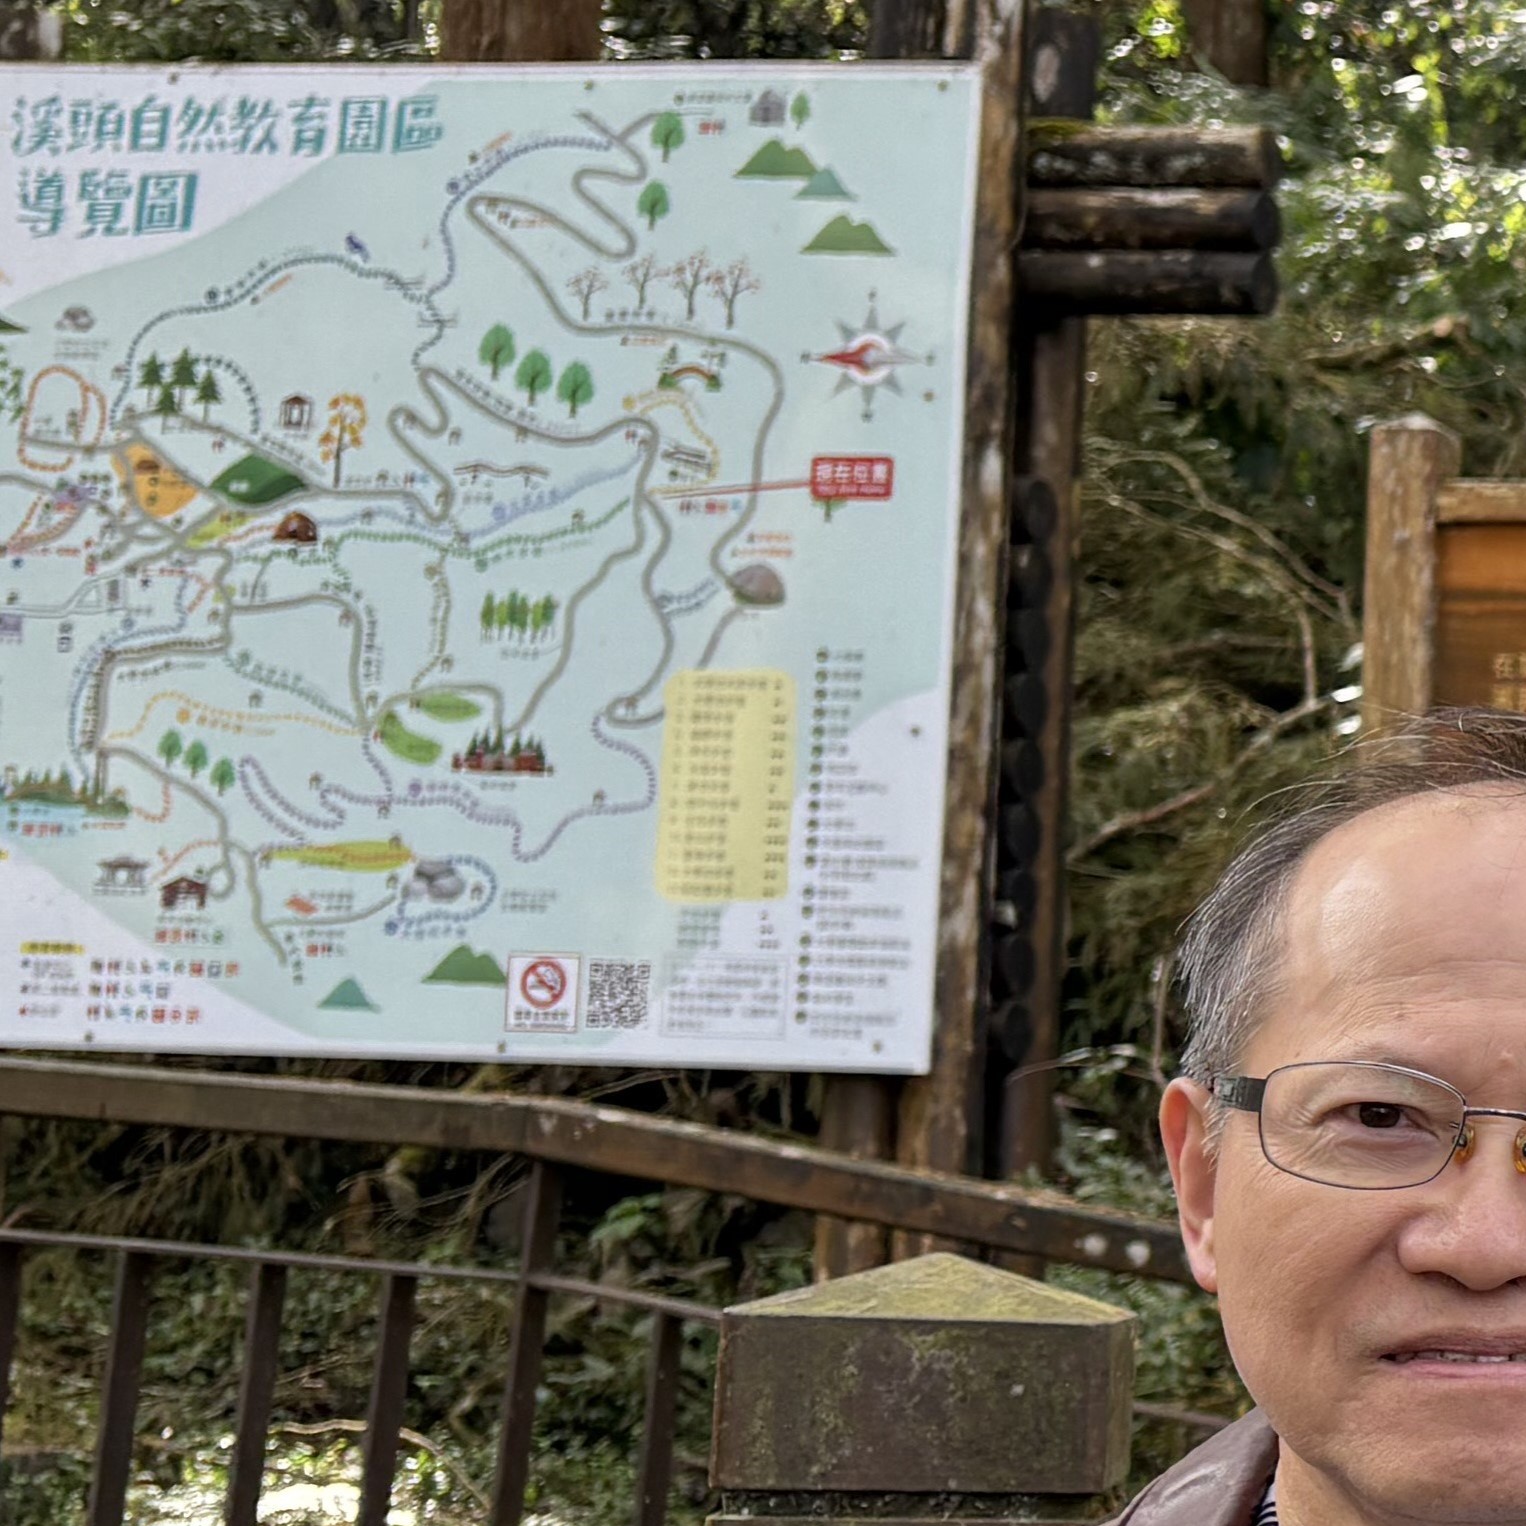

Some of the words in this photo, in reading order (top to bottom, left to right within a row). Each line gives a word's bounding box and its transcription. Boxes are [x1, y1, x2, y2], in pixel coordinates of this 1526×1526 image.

[9, 91, 446, 158] 溪頭自然教育園區
[15, 165, 200, 240] 導覽圖
